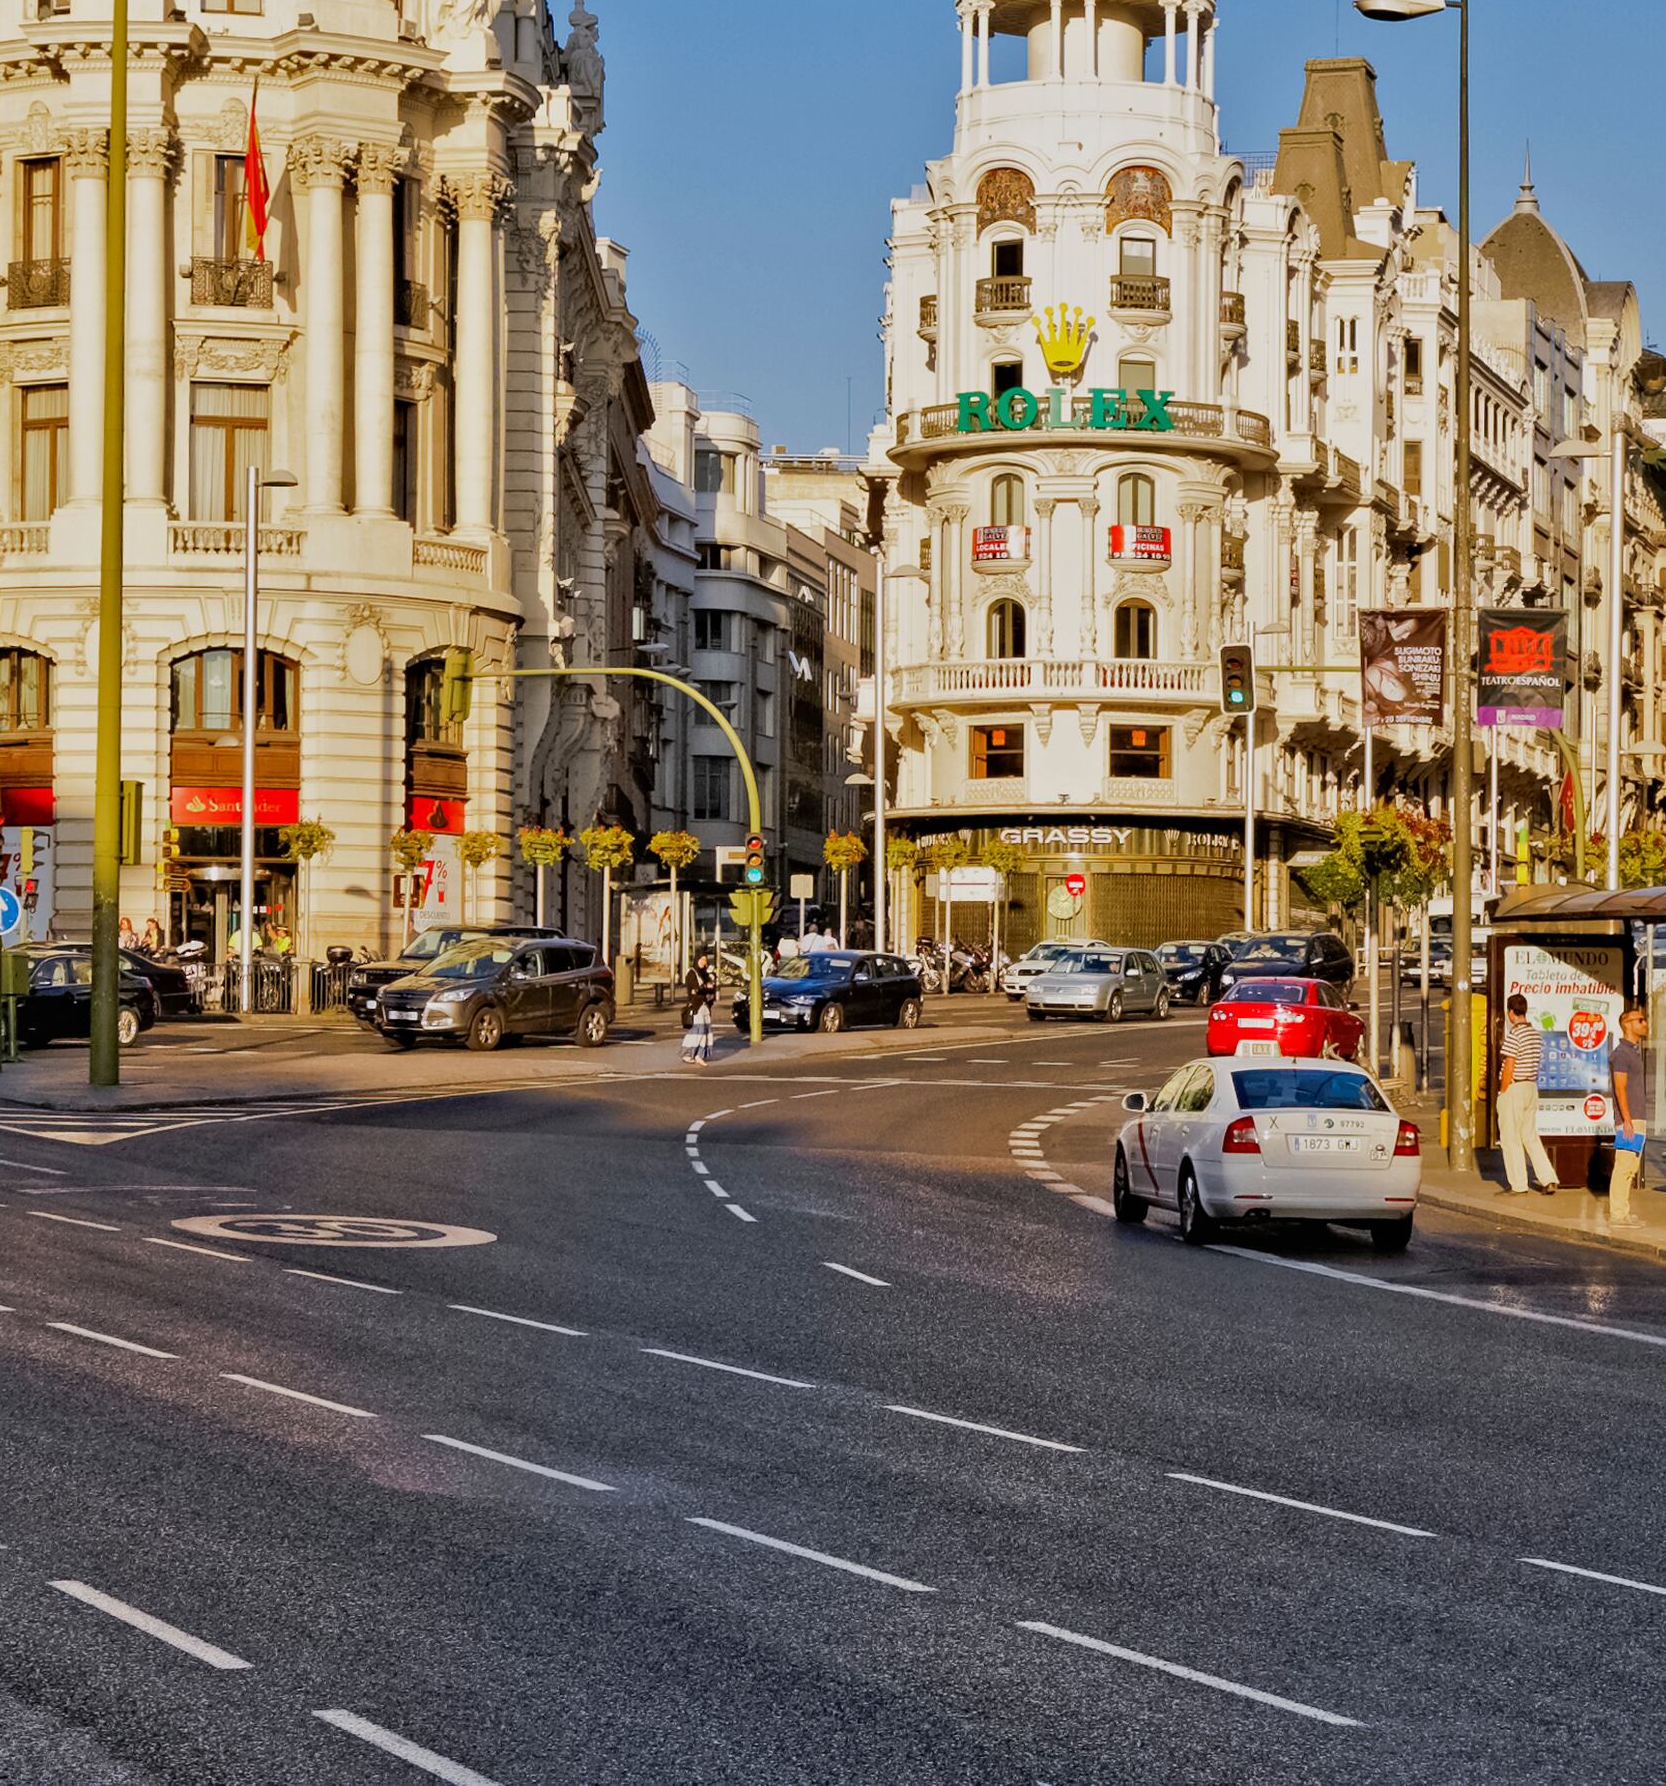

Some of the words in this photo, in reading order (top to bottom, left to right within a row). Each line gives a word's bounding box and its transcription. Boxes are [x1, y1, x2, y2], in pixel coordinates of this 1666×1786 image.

[955, 386, 1175, 432] ROLEX
[1394, 646, 1442, 656] SUGIMOTO
[1000, 827, 1133, 845] GRASSY
[1548, 950, 1609, 966] MUNDO
[1525, 968, 1567, 981] Tableta
[1569, 969, 1584, 981] de
[1509, 981, 1551, 994] Precio
[1555, 981, 1617, 995] imbatible
[1303, 1138, 1331, 1150] 1873
